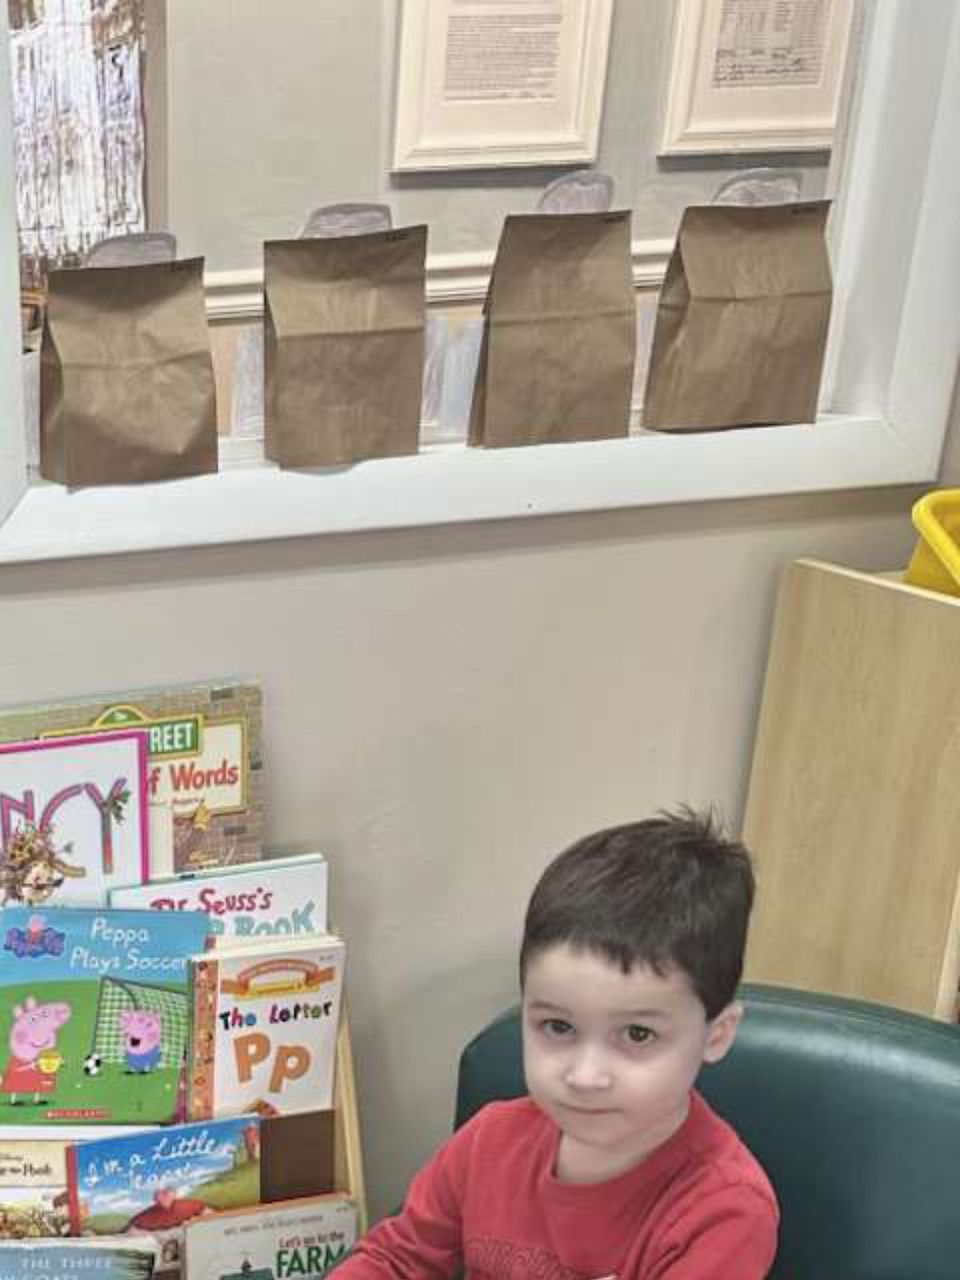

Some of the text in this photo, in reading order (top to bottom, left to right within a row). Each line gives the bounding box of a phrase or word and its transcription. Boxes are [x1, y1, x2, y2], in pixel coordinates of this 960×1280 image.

[149, 721, 194, 752] REET
[169, 758, 238, 791] Words
[195, 887, 273, 916] Seuss's
[91, 916, 150, 944] Peppa
[69, 947, 186, 971] Plays Soccer
[219, 1001, 333, 1031] The Letter
[233, 1032, 312, 1094] Pp
[151, 1130, 217, 1162] Little
[276, 1242, 346, 1279] FARM
